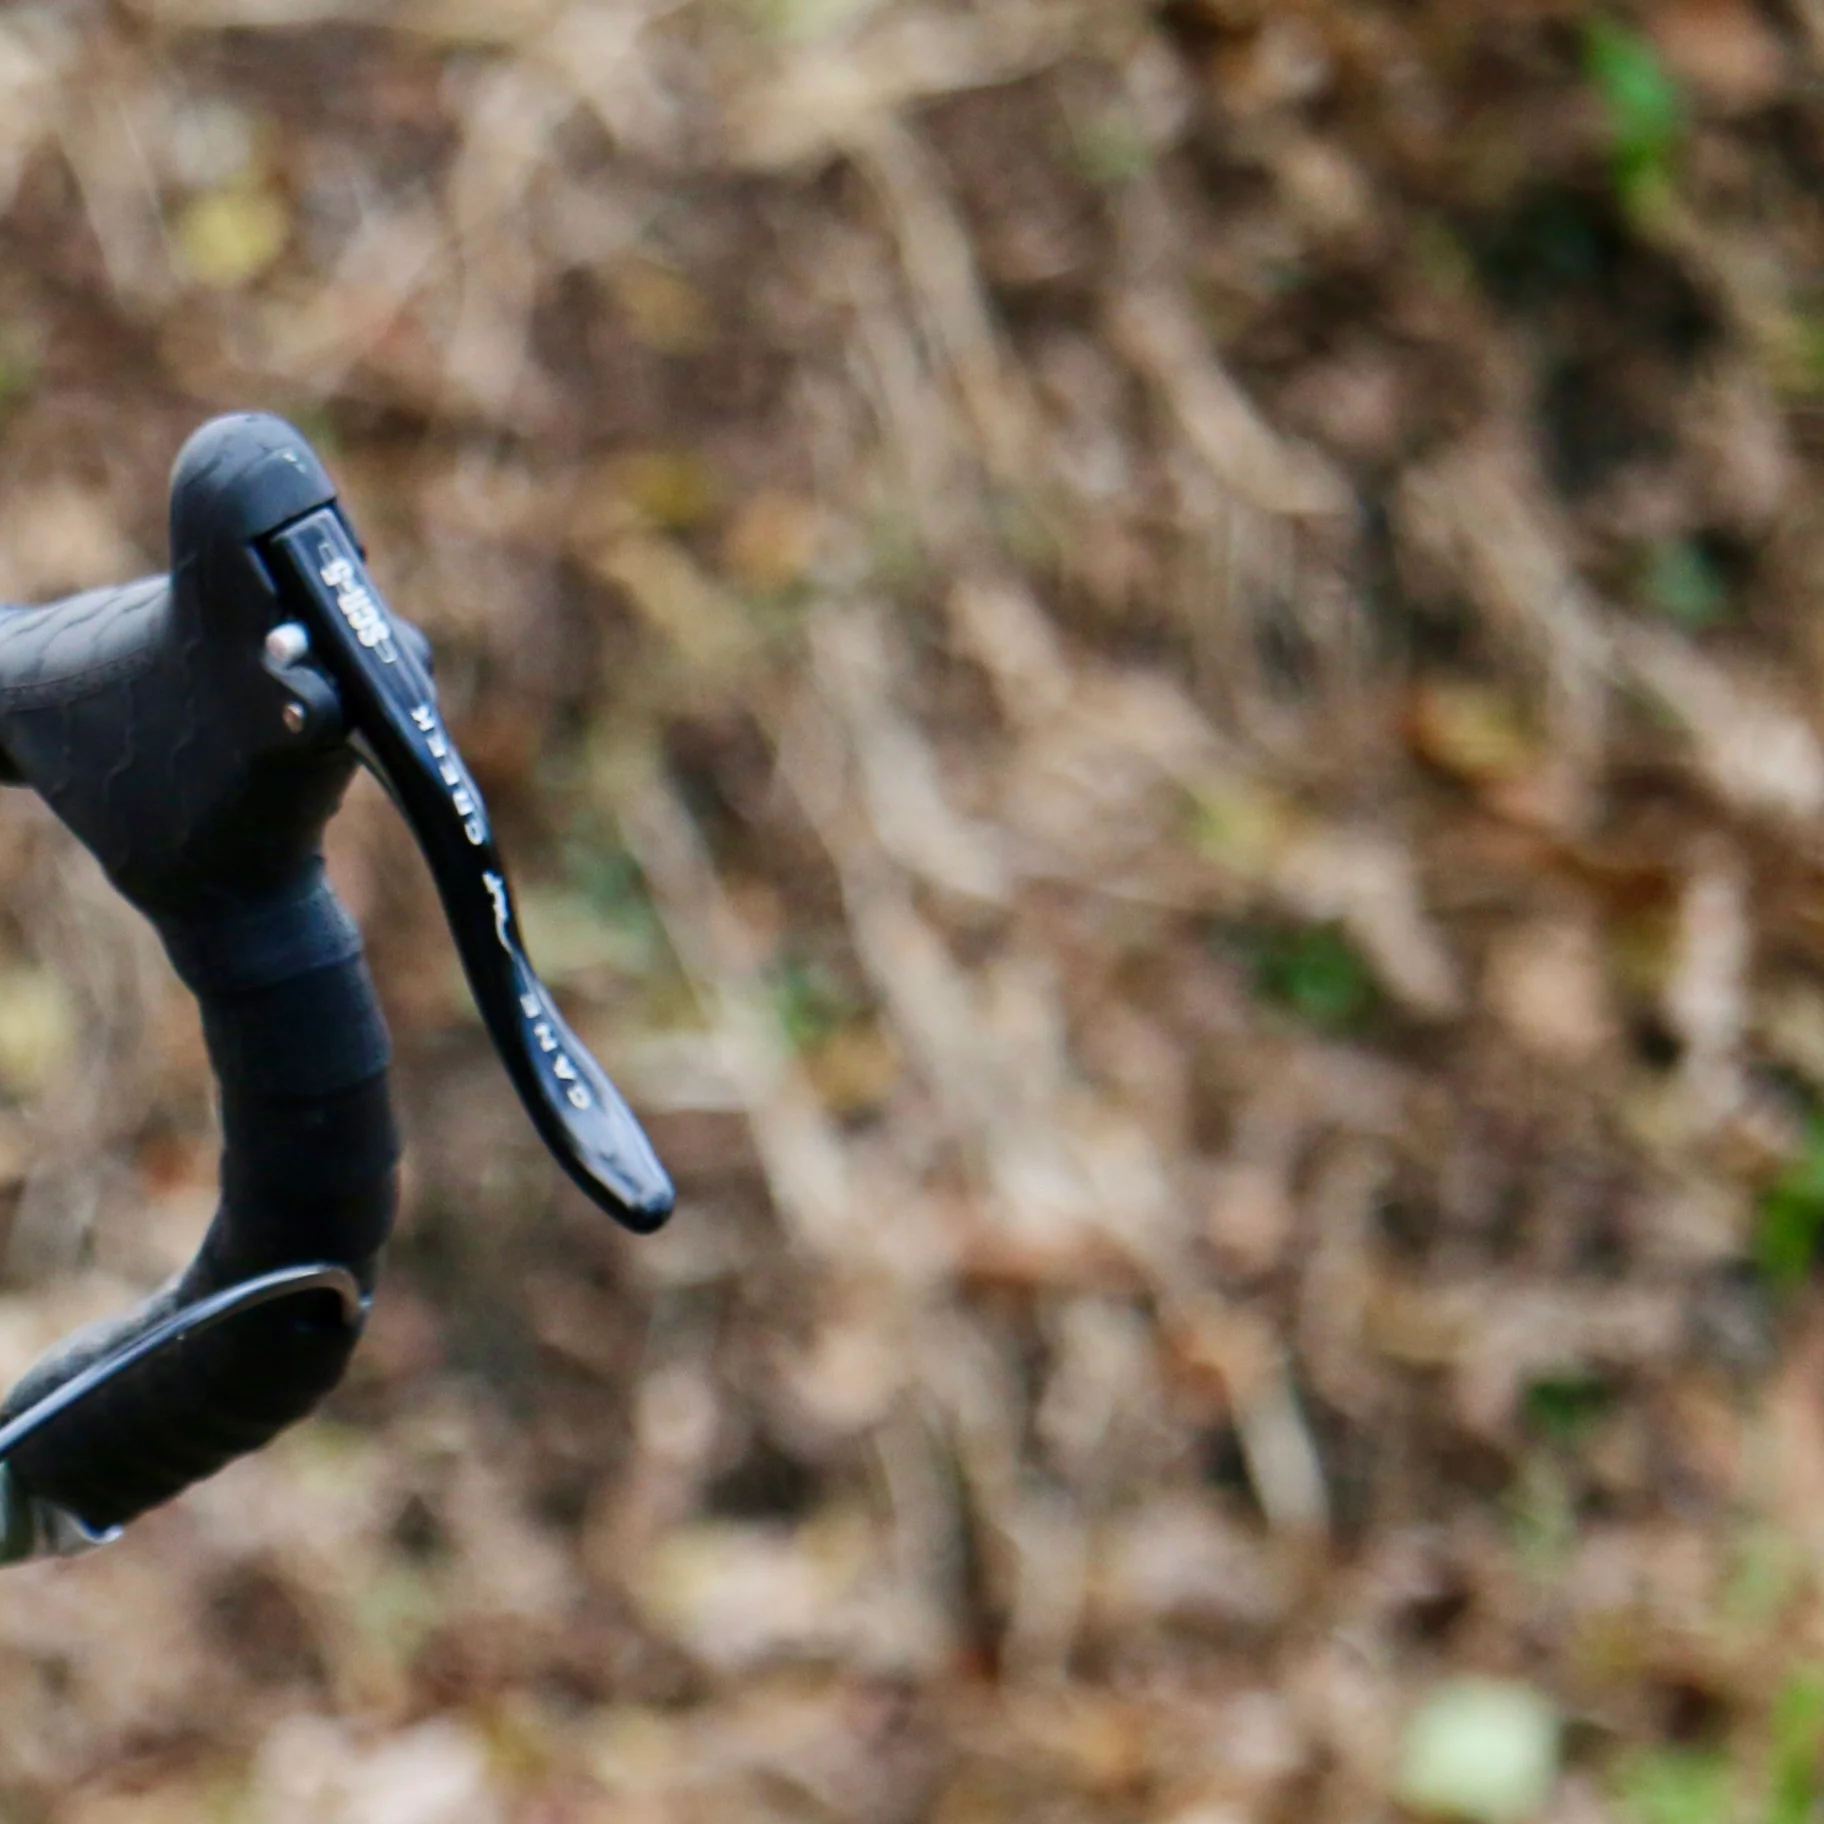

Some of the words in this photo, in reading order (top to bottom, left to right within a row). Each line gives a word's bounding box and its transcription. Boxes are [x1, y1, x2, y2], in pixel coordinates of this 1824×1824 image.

[319, 556, 391, 650] SCR-5
[409, 703, 487, 846] CREEK
[519, 988, 592, 1111] CANE
